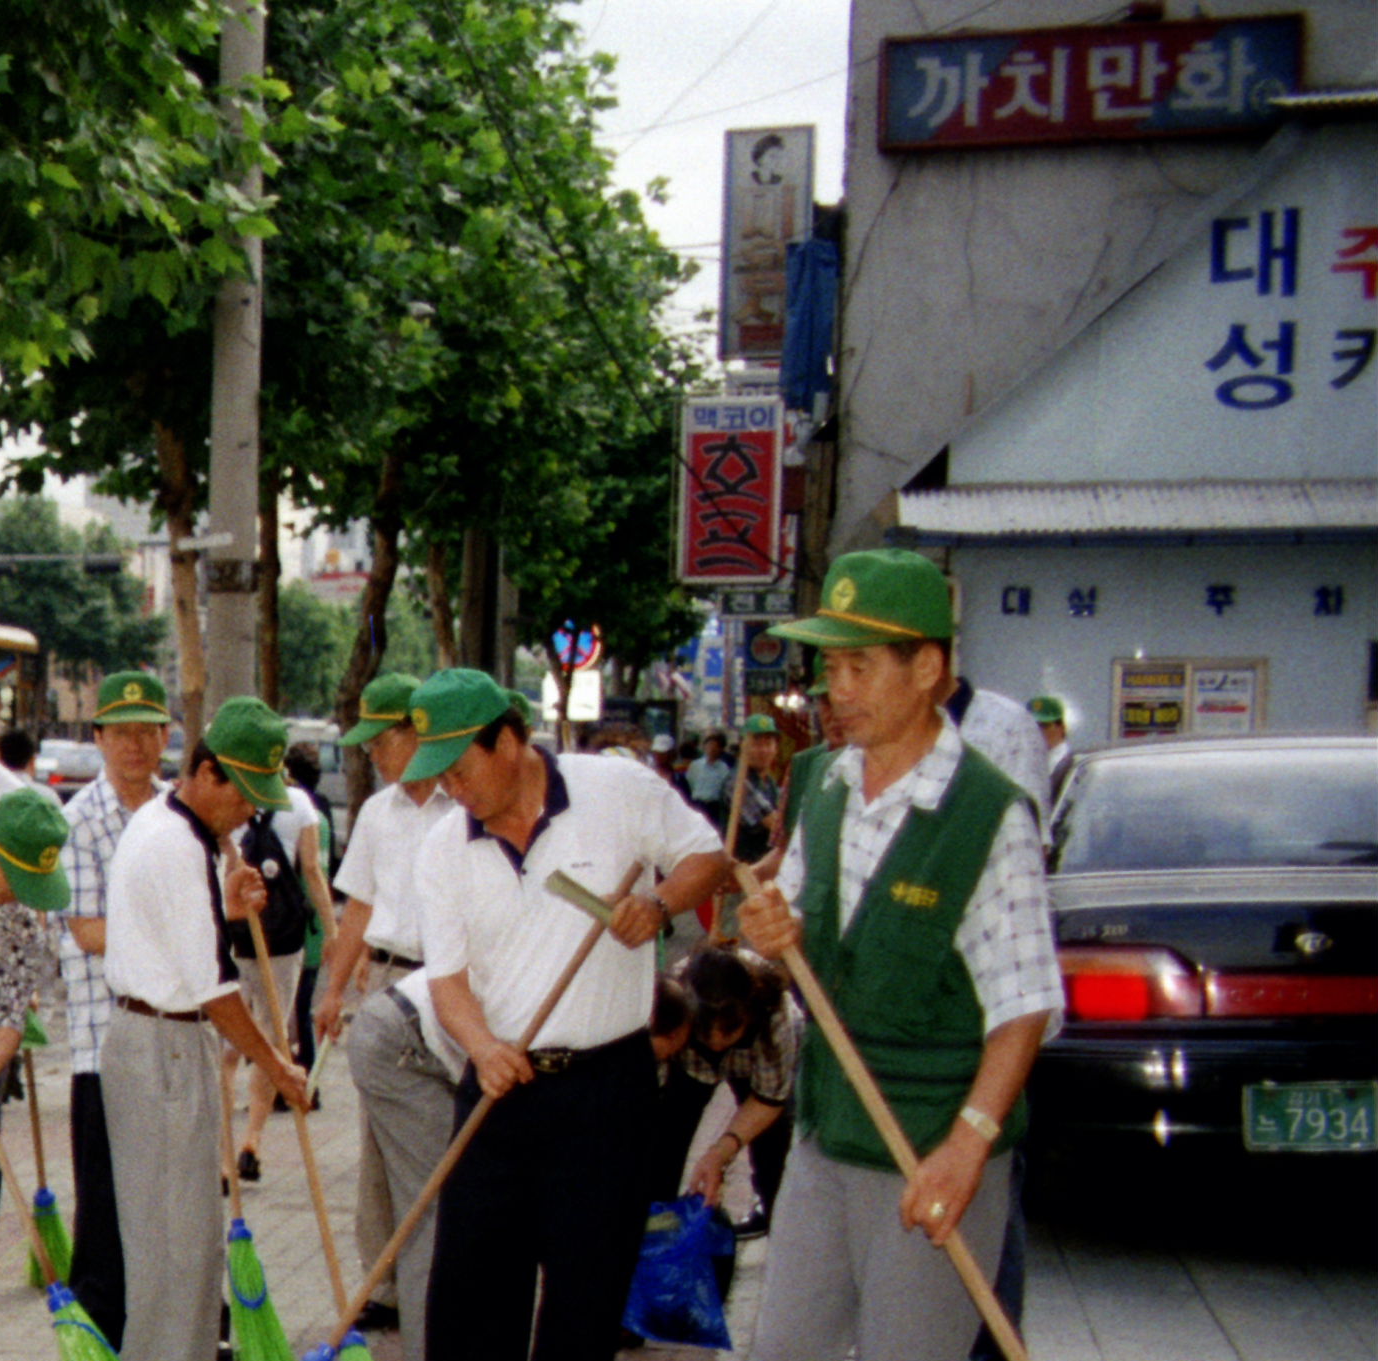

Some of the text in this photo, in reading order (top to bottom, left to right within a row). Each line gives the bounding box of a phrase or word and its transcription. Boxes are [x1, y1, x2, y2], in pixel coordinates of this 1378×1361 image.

[907, 37, 1257, 128] 까치만화
[694, 405, 776, 430] 맥코이
[1285, 1105, 1369, 1142] 7934
